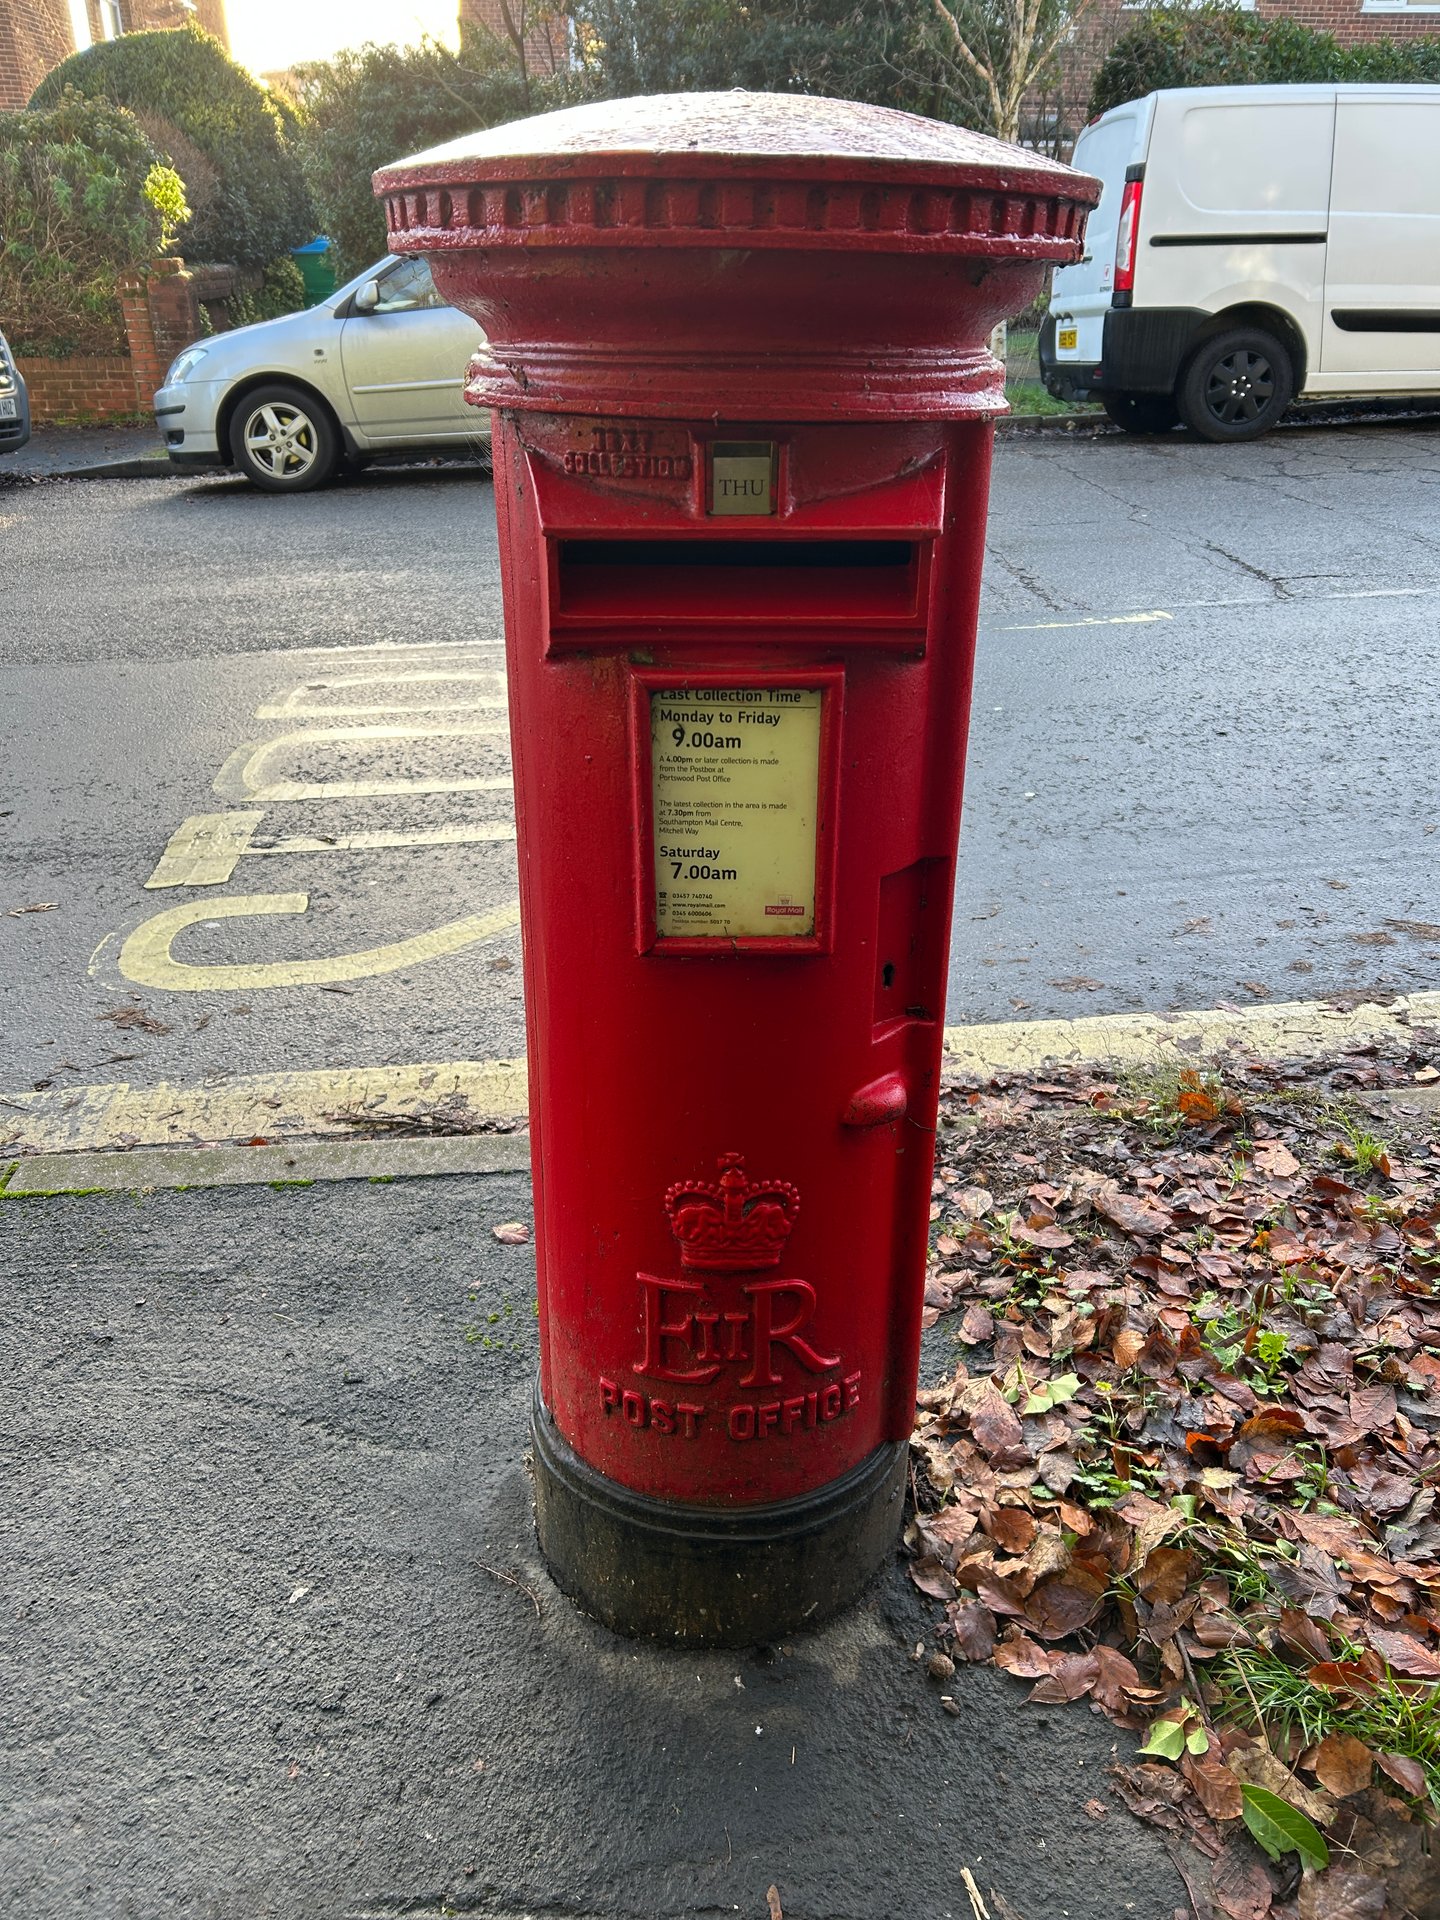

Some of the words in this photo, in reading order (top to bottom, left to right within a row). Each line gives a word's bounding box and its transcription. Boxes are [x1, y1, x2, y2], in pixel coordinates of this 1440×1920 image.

[563, 449, 692, 481] COLLECTION
[718, 479, 765, 496] THU
[660, 690, 690, 700] Last
[695, 690, 762, 703] Collection
[768, 691, 801, 703] Time
[660, 709, 714, 726] Monday
[719, 711, 733, 723] to
[738, 711, 781, 727] Friday
[672, 727, 742, 749] 9.00am
[659, 756, 665, 764] A
[666, 756, 693, 765] 4.00pm
[704, 757, 719, 765] later
[720, 757, 752, 765] collection
[760, 758, 780, 766] made
[659, 765, 676, 773] from
[659, 774, 694, 782] Portswood
[696, 775, 711, 783] Post
[712, 775, 732, 783] Office
[659, 799, 672, 807] The
[673, 800, 692, 808] latest
[693, 801, 723, 809] collection
[724, 801, 732, 809] in
[769, 802, 788, 810] made
[667, 809, 694, 818] 7.30pm
[659, 818, 703, 827] Southampton
[705, 819, 719, 827] Mail
[720, 819, 744, 828] Centre,
[659, 827, 684, 835] Mitchell
[685, 828, 699, 837] Way
[660, 846, 720, 860] Saturday
[670, 862, 737, 880] 7.00am
[599, 1376, 705, 1440] POST
[729, 1370, 862, 1441] OFFICE
